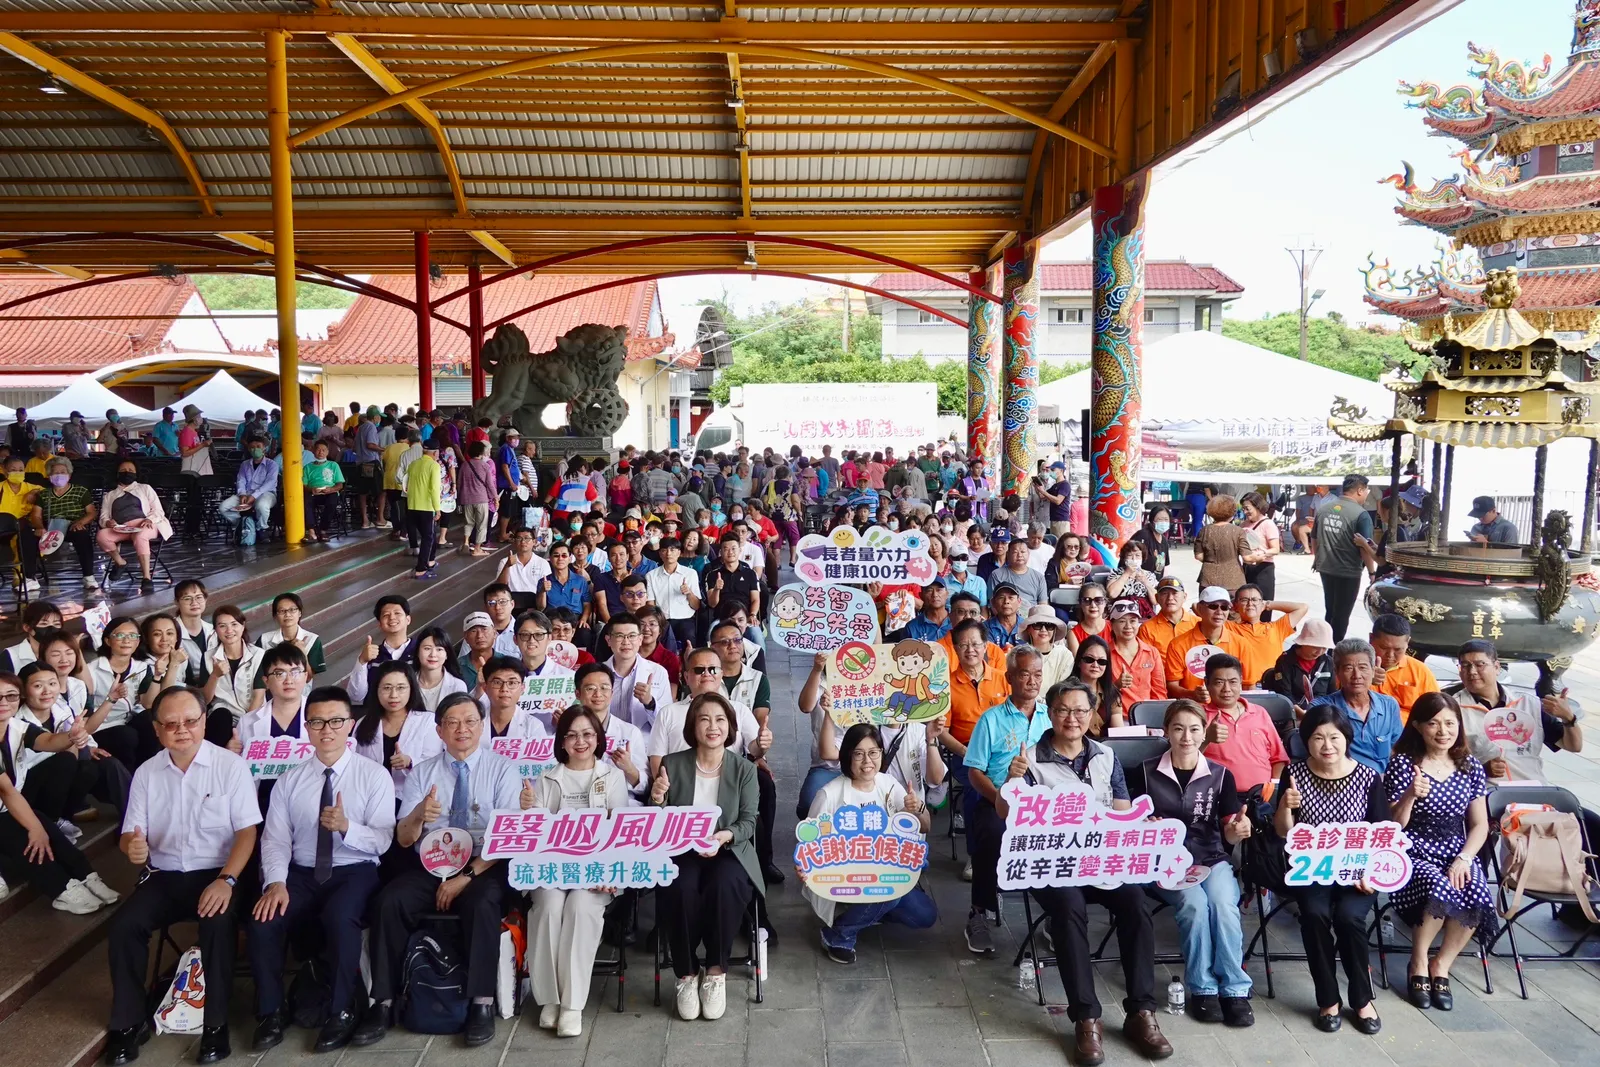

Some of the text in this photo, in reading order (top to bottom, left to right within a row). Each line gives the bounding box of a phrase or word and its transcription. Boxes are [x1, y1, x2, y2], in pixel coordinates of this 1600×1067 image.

[822, 546, 911, 562] 長者量六力
[824, 564, 910, 580] 健康100分
[805, 587, 852, 611] 失智
[801, 610, 873, 639] 不失愛
[831, 682, 886, 699] 營造無檳
[517, 698, 567, 711] 利又安心
[833, 697, 885, 710] 支持性環境
[1015, 792, 1087, 827] 改變
[839, 811, 882, 831] 遠離
[487, 810, 716, 857] 醫帆風順
[1009, 828, 1178, 852] 讓琉球人的看病日常
[1290, 826, 1396, 850] 急診醫療
[797, 835, 925, 869] 代謝症候群
[1290, 853, 1369, 881] 24 小時
[1338, 868, 1366, 881] 守護
[1373, 861, 1397, 874] 24h
